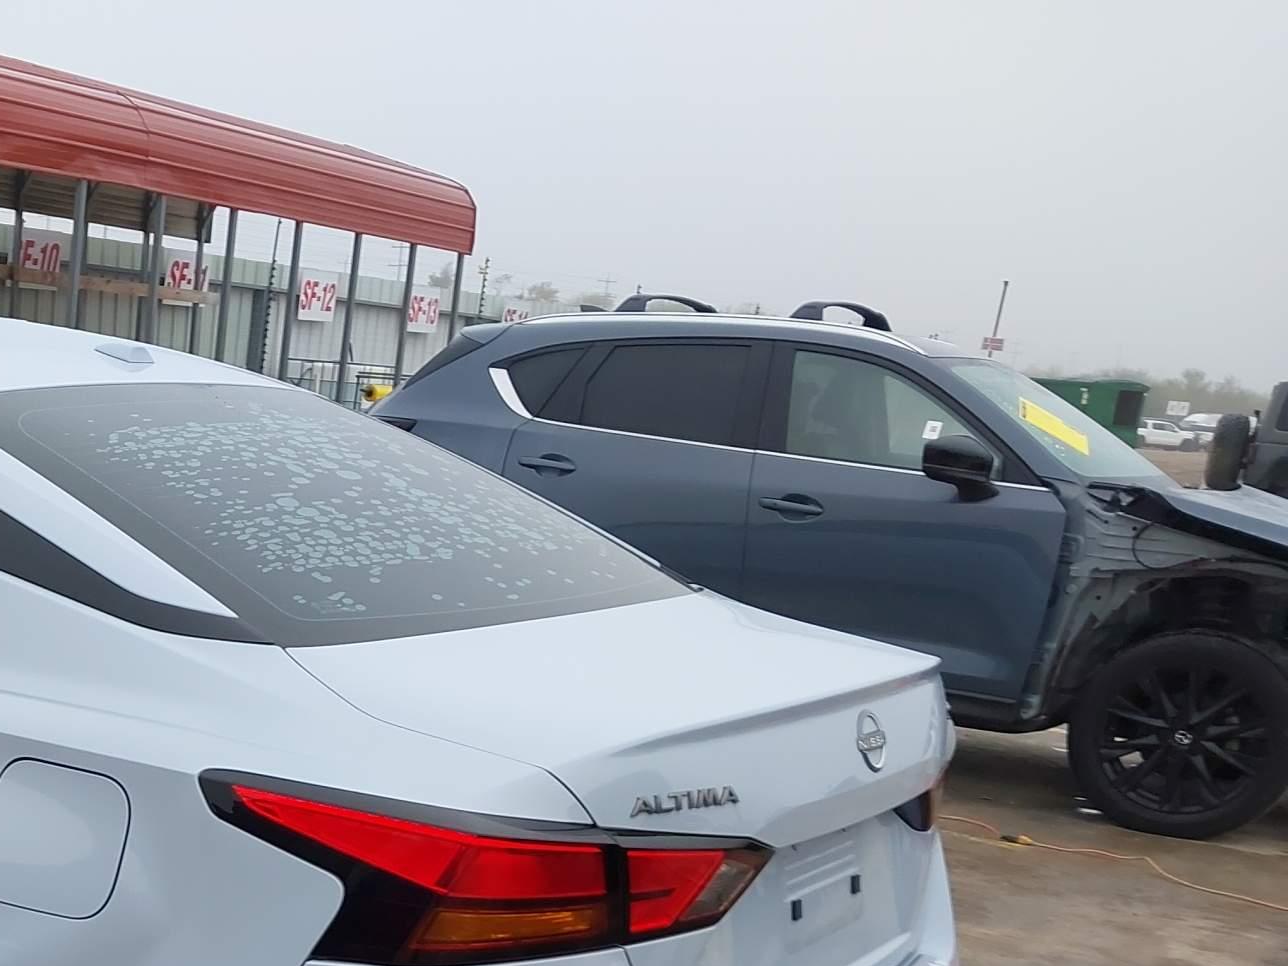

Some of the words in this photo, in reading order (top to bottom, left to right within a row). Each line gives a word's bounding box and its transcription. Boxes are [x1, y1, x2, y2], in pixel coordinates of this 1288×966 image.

[19, 239, 61, 272] F-10
[168, 260, 209, 291] SF-1
[300, 279, 337, 312] SF-12
[408, 295, 439, 325] SF-13
[630, 784, 740, 818] ALTIMA
